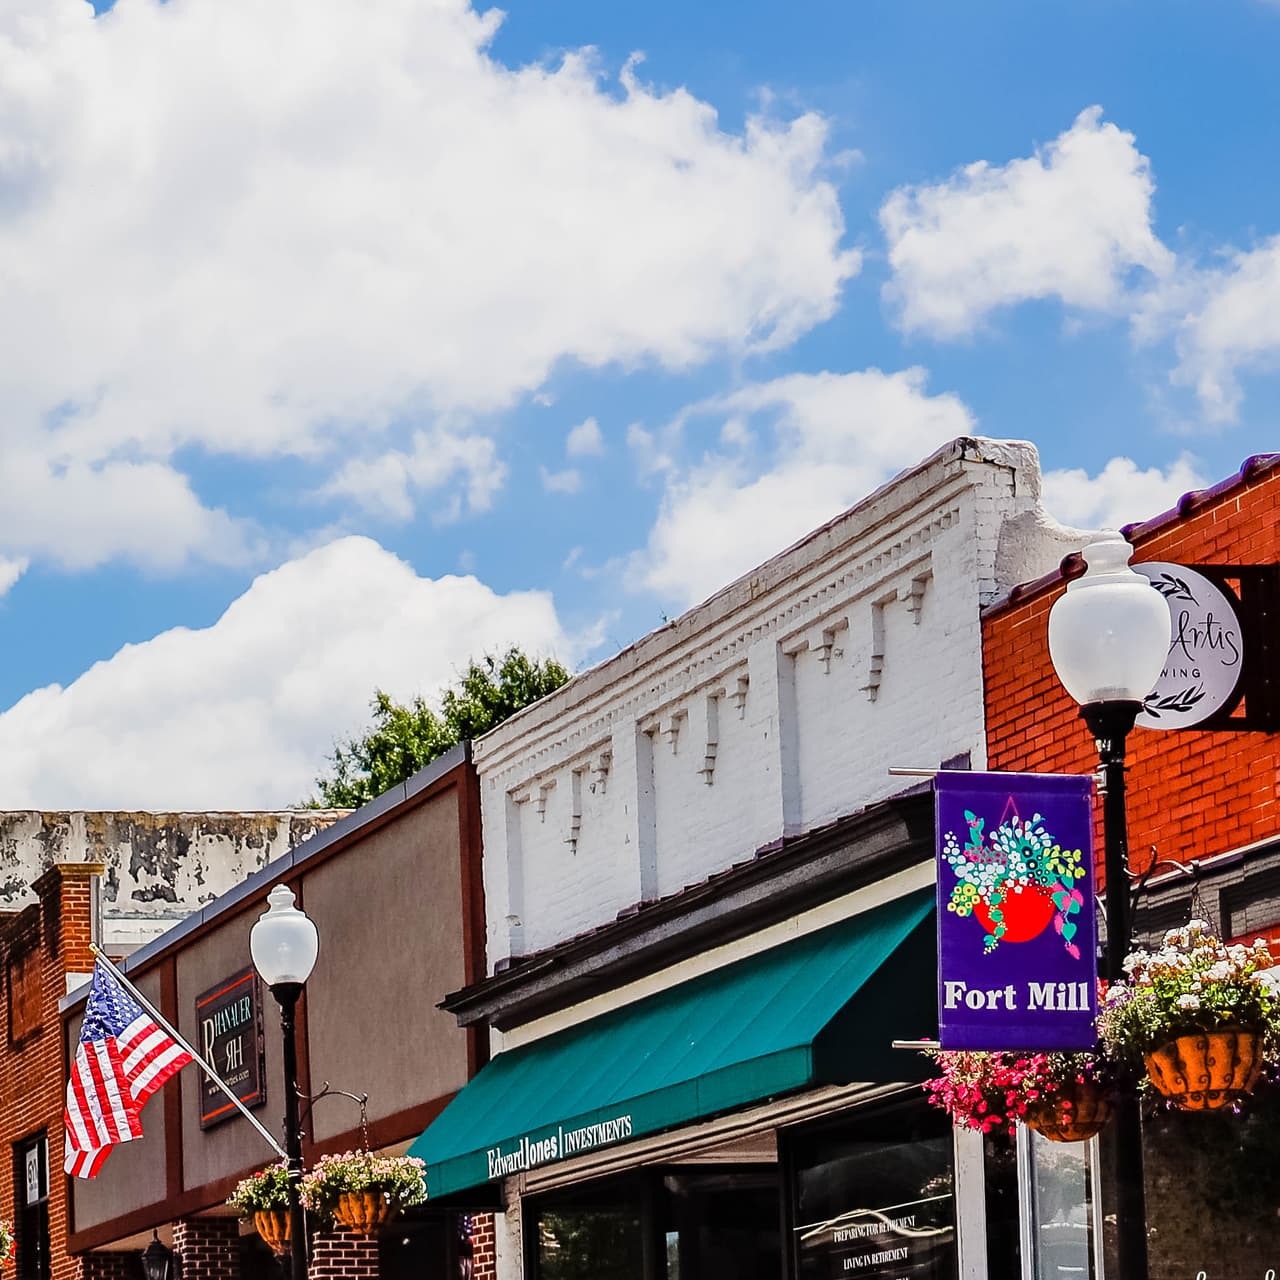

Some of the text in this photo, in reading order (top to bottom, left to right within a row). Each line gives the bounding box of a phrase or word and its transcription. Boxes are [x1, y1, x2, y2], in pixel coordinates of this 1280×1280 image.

[1168, 610, 1239, 666] Artis
[943, 981, 1090, 1011] Fort Mill
[564, 1114, 633, 1153] INVESTMENTS
[833, 1215, 916, 1243] PREPARING FOR RETIREMENT
[843, 1247, 909, 1271] LIVING IN RETIREMENT
